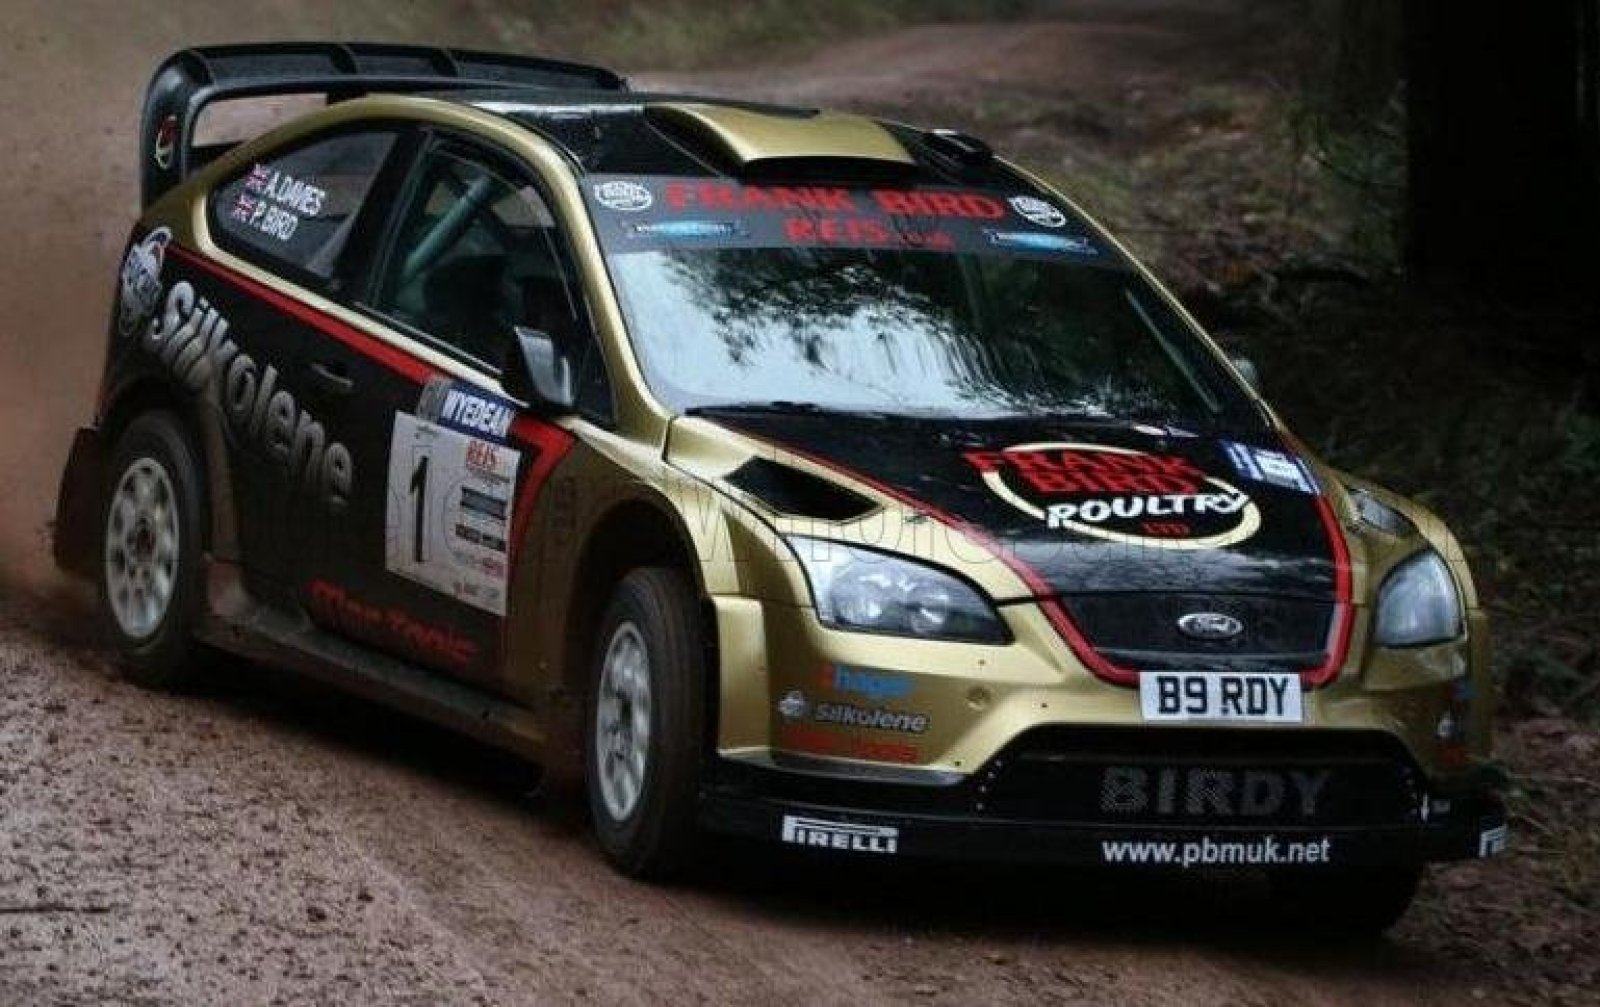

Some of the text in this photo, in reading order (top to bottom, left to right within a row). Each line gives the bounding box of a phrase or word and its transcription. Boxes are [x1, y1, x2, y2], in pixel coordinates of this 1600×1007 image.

[664, 183, 853, 212] FRANK
[872, 190, 1007, 218] BIRD
[148, 280, 352, 505] Silkolene
[441, 388, 516, 438] WYEDEAN
[408, 455, 429, 563] 1
[1046, 491, 1250, 529] POULTRY
[1156, 674, 1291, 717] B9 RDY
[1101, 766, 1332, 816] BIRDY
[781, 814, 899, 854] PIRELLI
[1102, 836, 1331, 868] www.pbmuk.net
